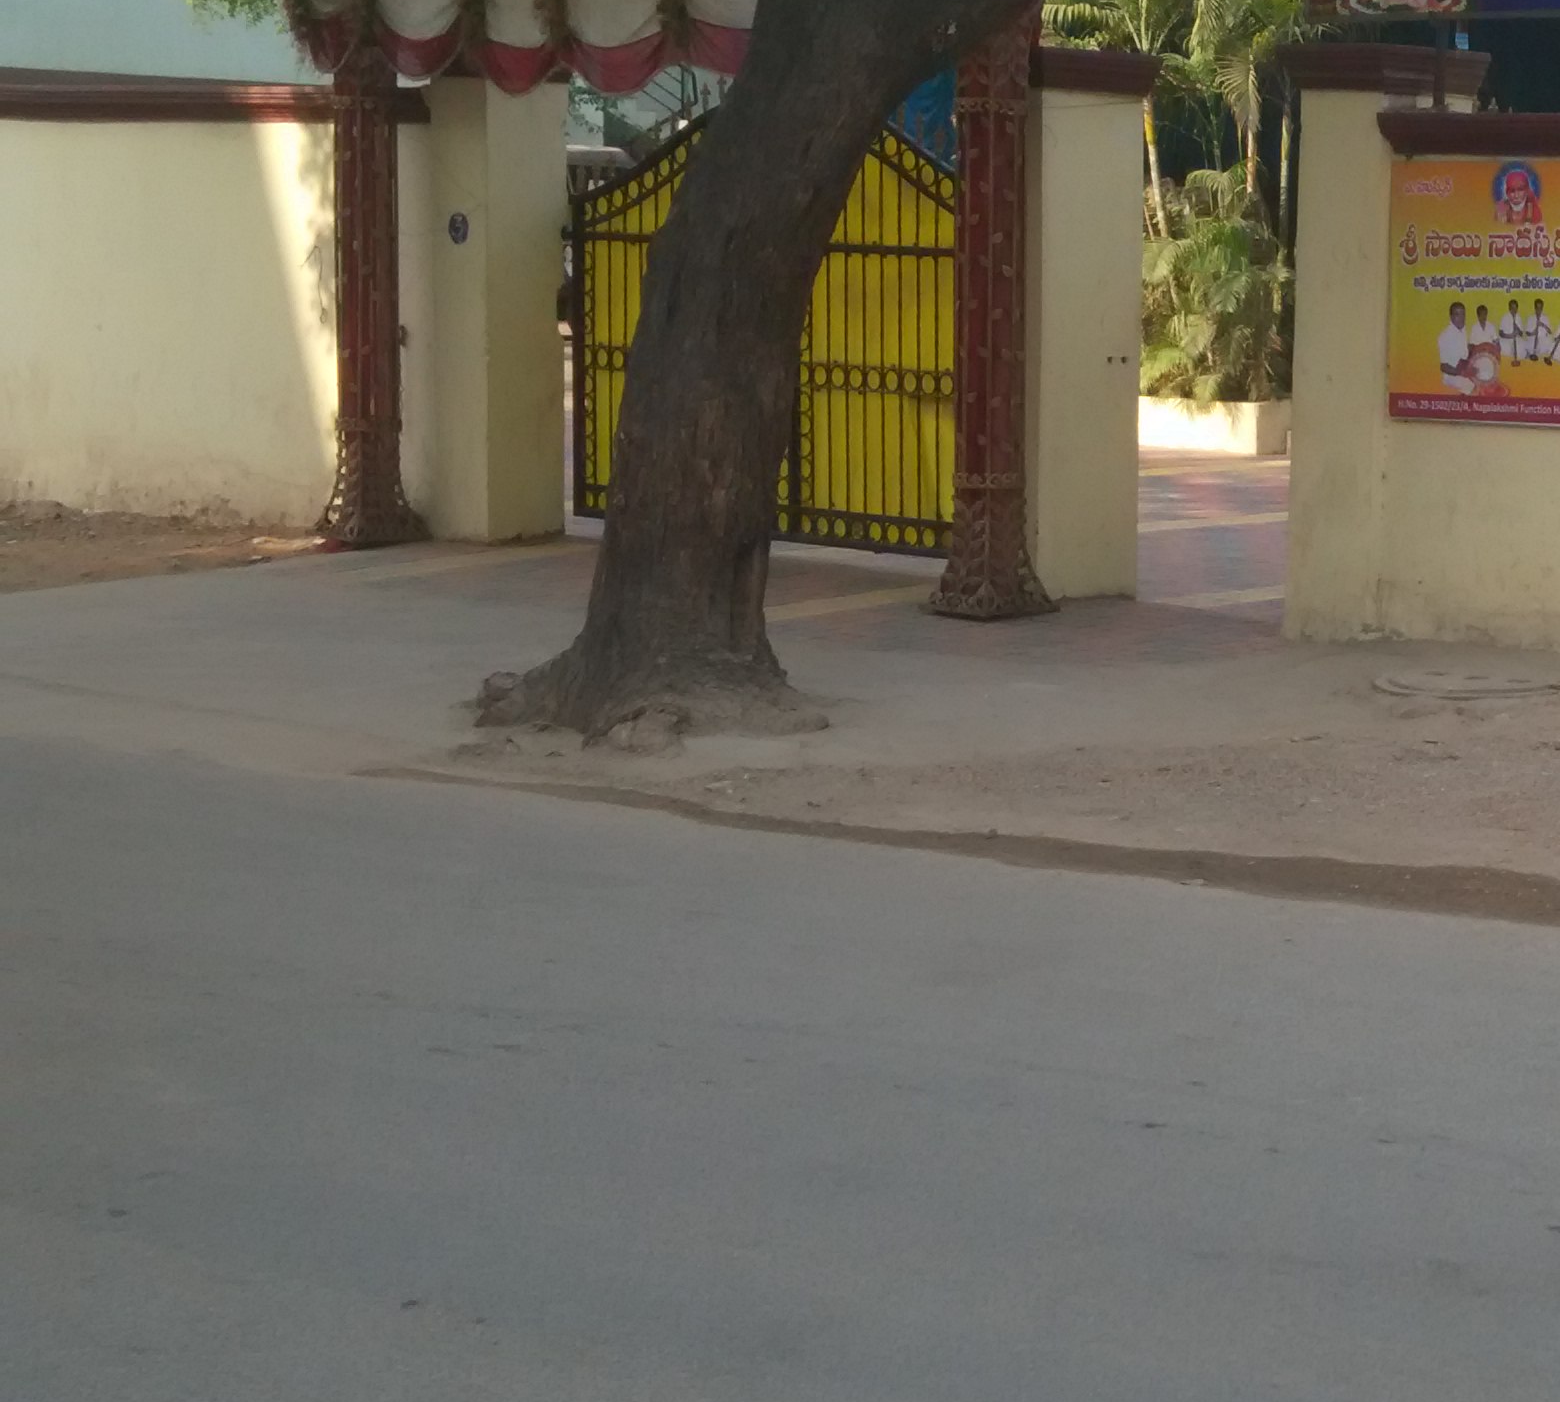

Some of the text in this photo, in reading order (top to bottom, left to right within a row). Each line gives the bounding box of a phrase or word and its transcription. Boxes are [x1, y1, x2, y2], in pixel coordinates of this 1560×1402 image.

[1399, 223, 1419, 266] శ్రీ
[1424, 229, 1482, 258] సాయి
[1520, 404, 1552, 415] Function
